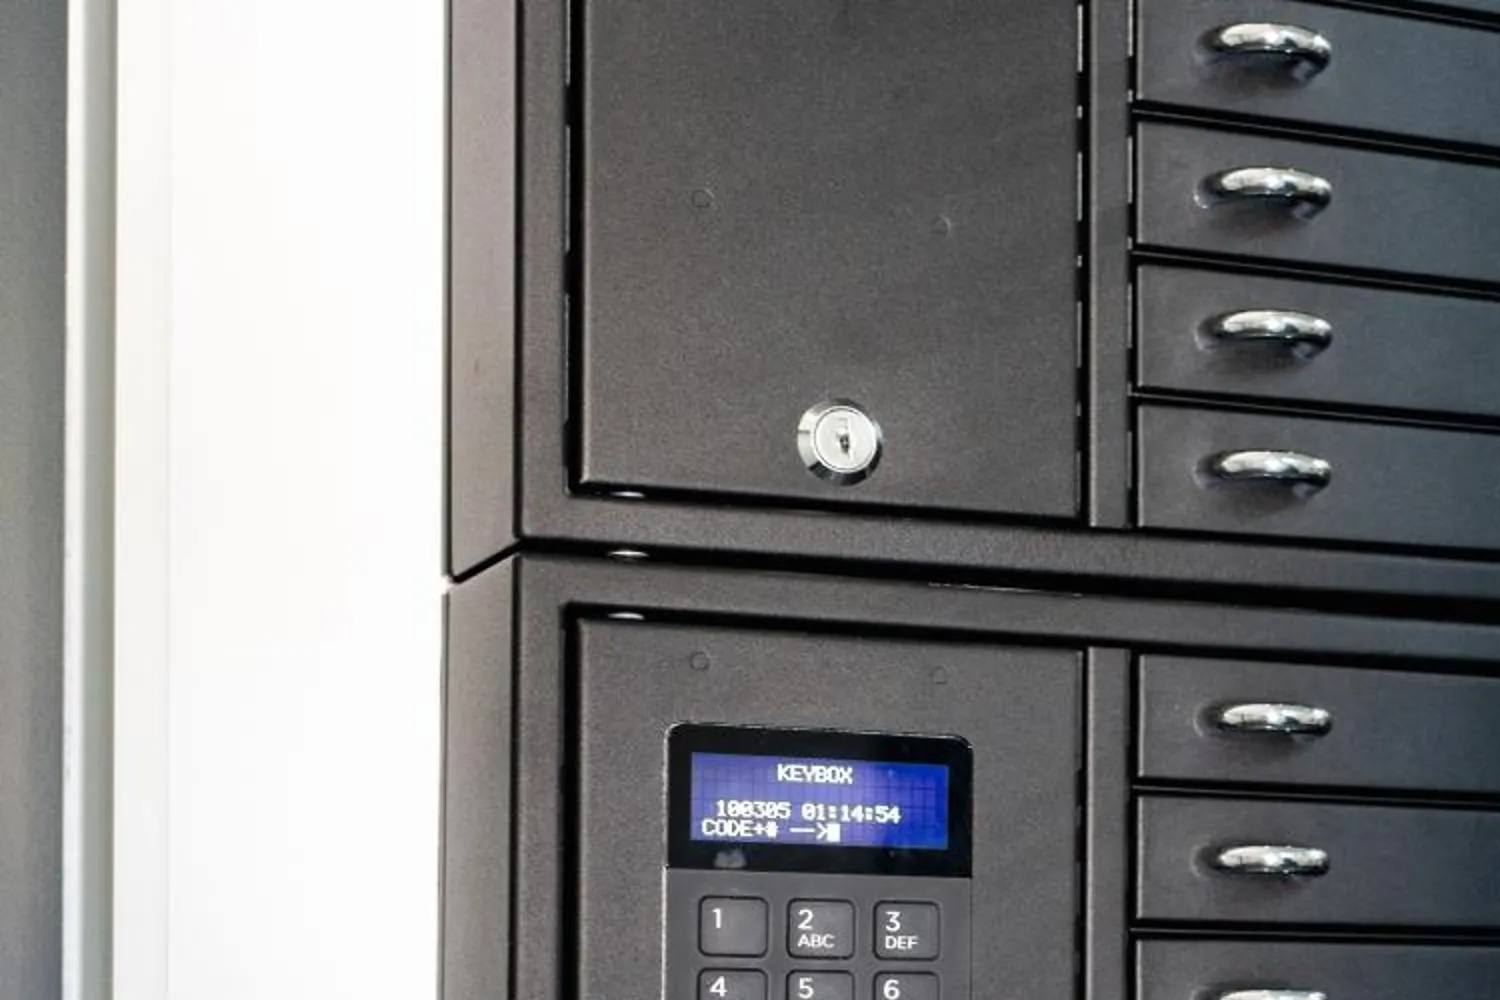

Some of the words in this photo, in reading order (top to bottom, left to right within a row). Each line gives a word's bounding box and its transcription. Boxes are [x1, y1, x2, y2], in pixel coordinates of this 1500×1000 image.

[777, 764, 853, 784] KEYBOX
[802, 804, 901, 824] 01:14:54
[712, 908, 722, 928] 1
[798, 909, 814, 930] 2
[885, 911, 901, 932] 3
[797, 934, 835, 949] ABC
[885, 936, 918, 950] DEF
[710, 976, 727, 998] 4
[798, 977, 814, 999] 5
[883, 979, 900, 1000] 6
